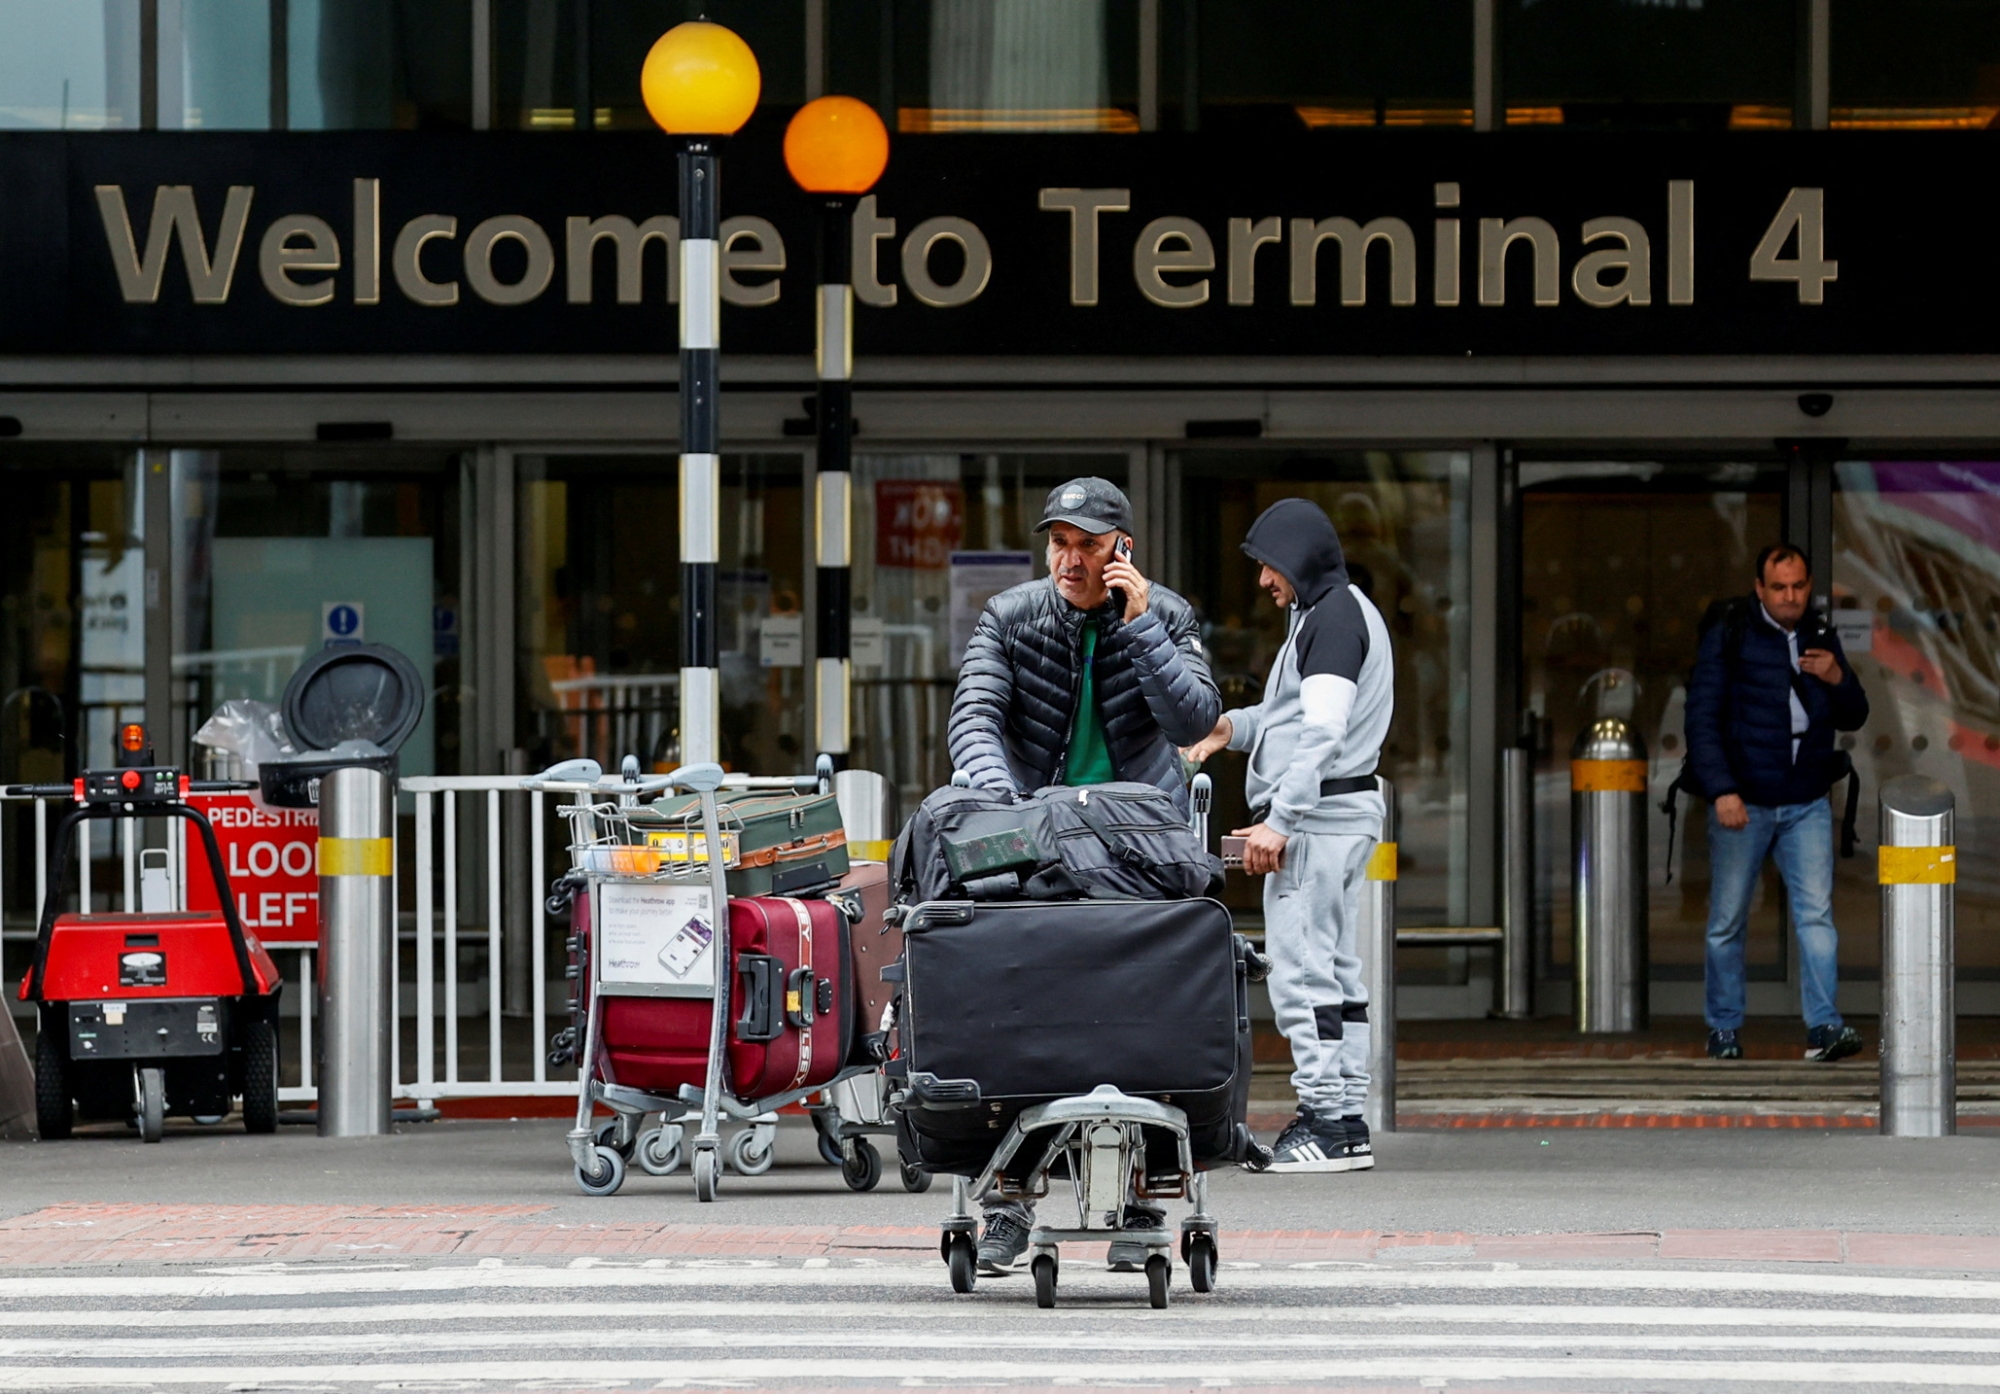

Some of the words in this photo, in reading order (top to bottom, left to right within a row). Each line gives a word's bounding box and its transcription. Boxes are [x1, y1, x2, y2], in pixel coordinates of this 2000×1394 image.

[94, 178, 787, 307] Welcome
[851, 195, 992, 307] to
[1039, 180, 1694, 308] Terminal
[1750, 187, 1838, 305] 4
[229, 840, 318, 877] LOO
[795, 1027, 810, 1085] LSEY
